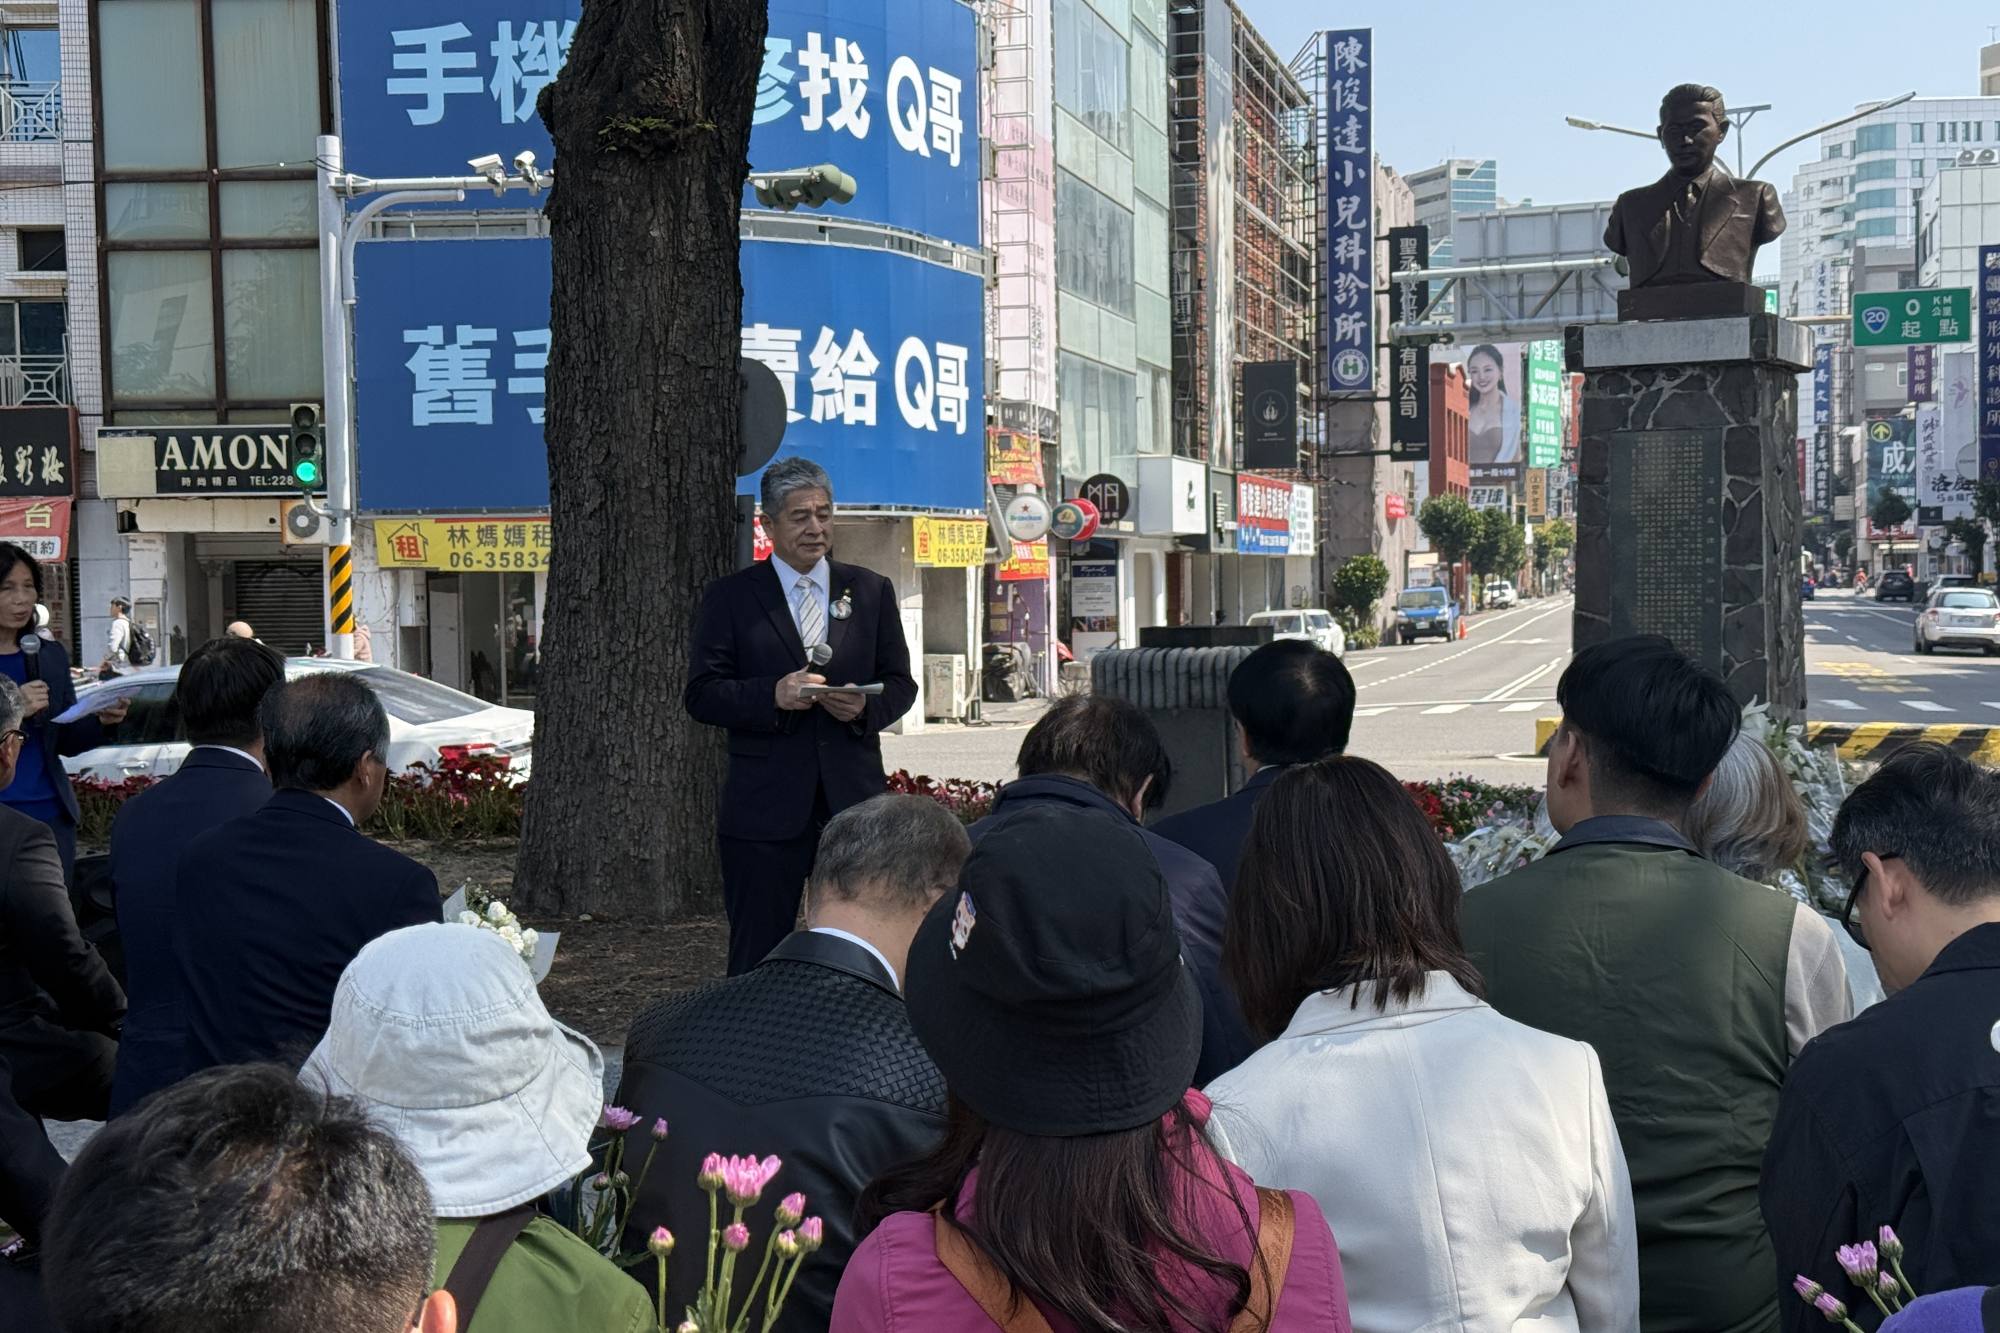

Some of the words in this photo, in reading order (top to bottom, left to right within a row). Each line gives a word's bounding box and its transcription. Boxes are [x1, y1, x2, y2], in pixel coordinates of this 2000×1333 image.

[386, 20, 578, 126] 手機
[1332, 36, 1369, 348] 陳俊達小兒科診所
[1866, 311, 1885, 323] 20
[1905, 299, 1921, 316] 0
[1931, 307, 1952, 317] 公里
[1901, 319, 1959, 338] 起點
[1914, 346, 1926, 395] 格診所
[181, 476, 238, 487] 時尚精品
[25, 502, 53, 529] 台
[395, 535, 422, 558] 租
[447, 524, 551, 549] 林媽媽租
[10, 541, 55, 555] 預約
